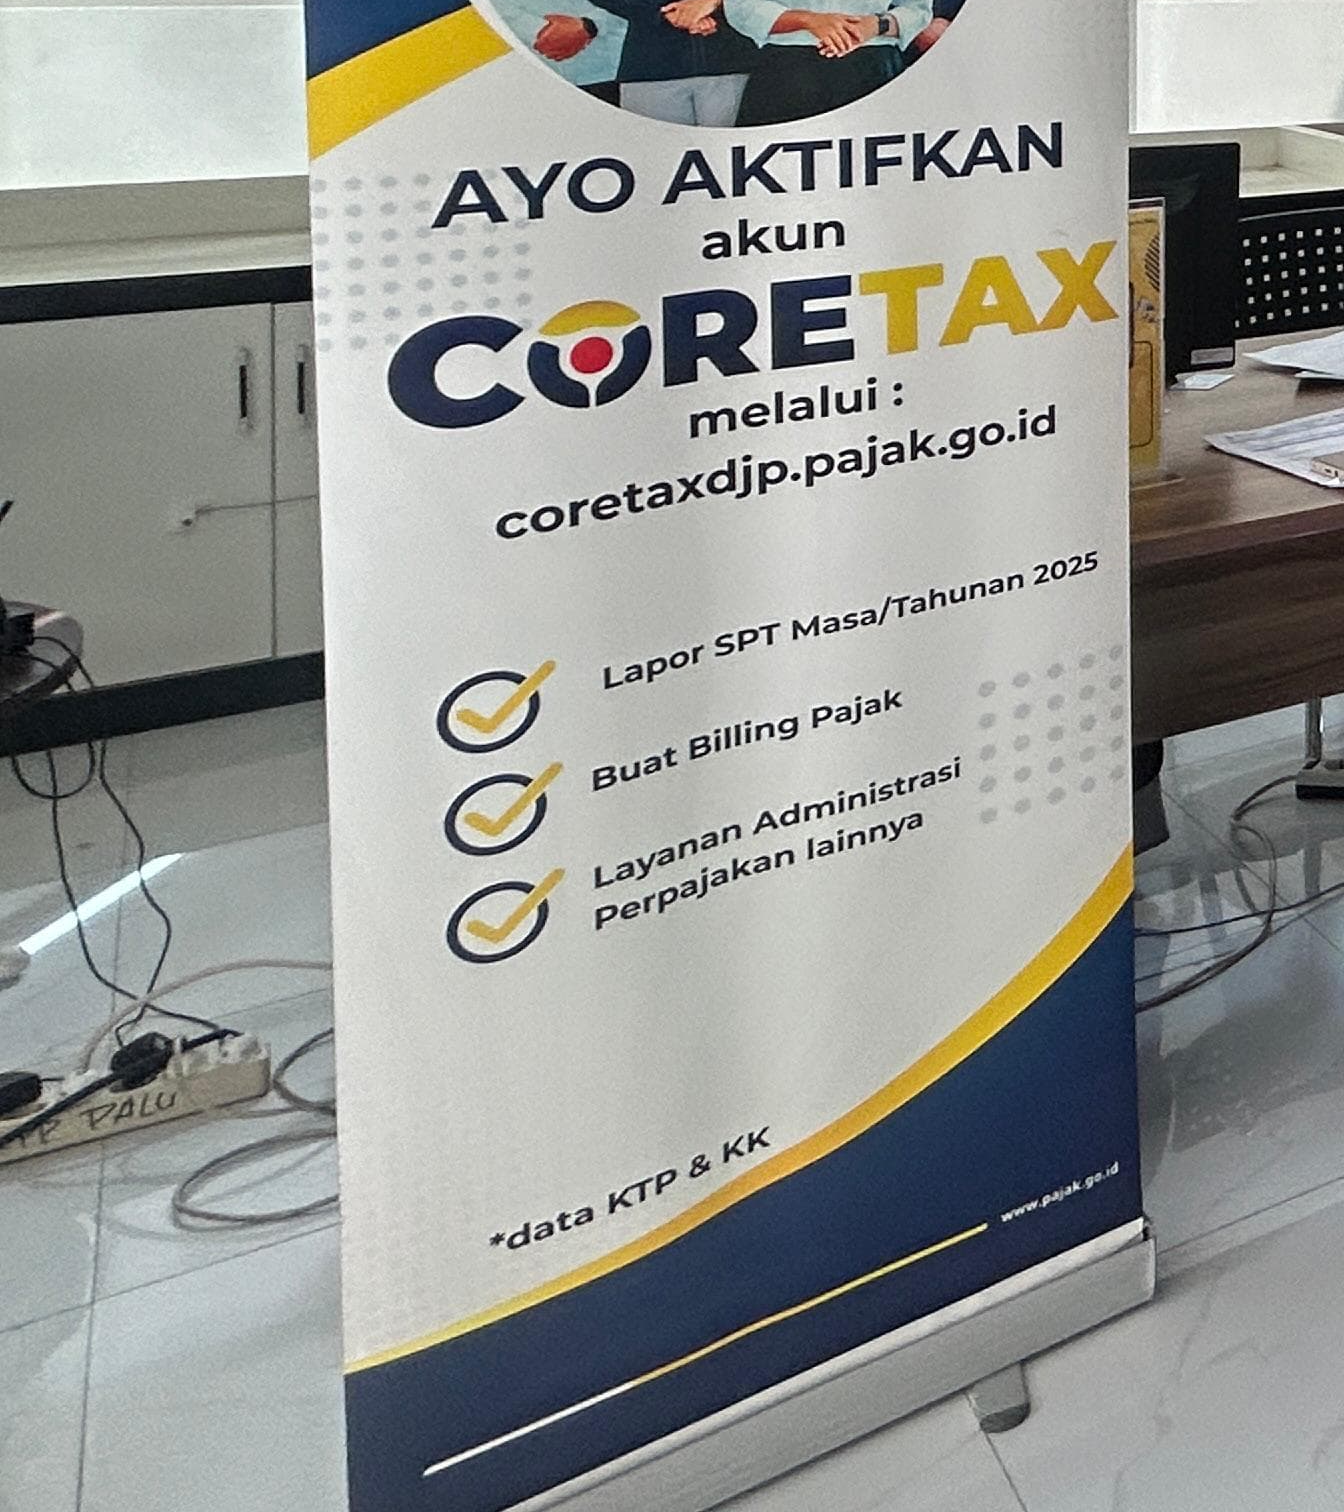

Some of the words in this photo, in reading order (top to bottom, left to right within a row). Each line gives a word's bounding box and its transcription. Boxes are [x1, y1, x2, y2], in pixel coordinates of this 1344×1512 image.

[432, 158, 635, 228] AYO
[662, 122, 1062, 205] AKTIFKAN
[703, 219, 844, 259] akun
[387, 240, 1120, 429] CORETAX
[691, 377, 876, 438] melalui
[497, 405, 1055, 539] coretaxdjp.pajak.go.id
[604, 645, 703, 689] Lapor
[715, 623, 780, 656] SPT
[793, 575, 1023, 640] Masa/Tahunan
[1034, 551, 1097, 585] 2025
[593, 748, 677, 791] Buat
[690, 717, 798, 760] Billing
[813, 690, 902, 728] Pajak
[595, 825, 741, 888] Layanan
[753, 757, 960, 834] Administrasi
[596, 850, 794, 930] Perpajakan
[808, 813, 922, 859] lainnya
[79, 1091, 177, 1131] PALU
[609, 1170, 677, 1214] KTP
[689, 1153, 712, 1178] &
[724, 1127, 769, 1163] KK
[1001, 1162, 1118, 1221] www.pajak.go.id
